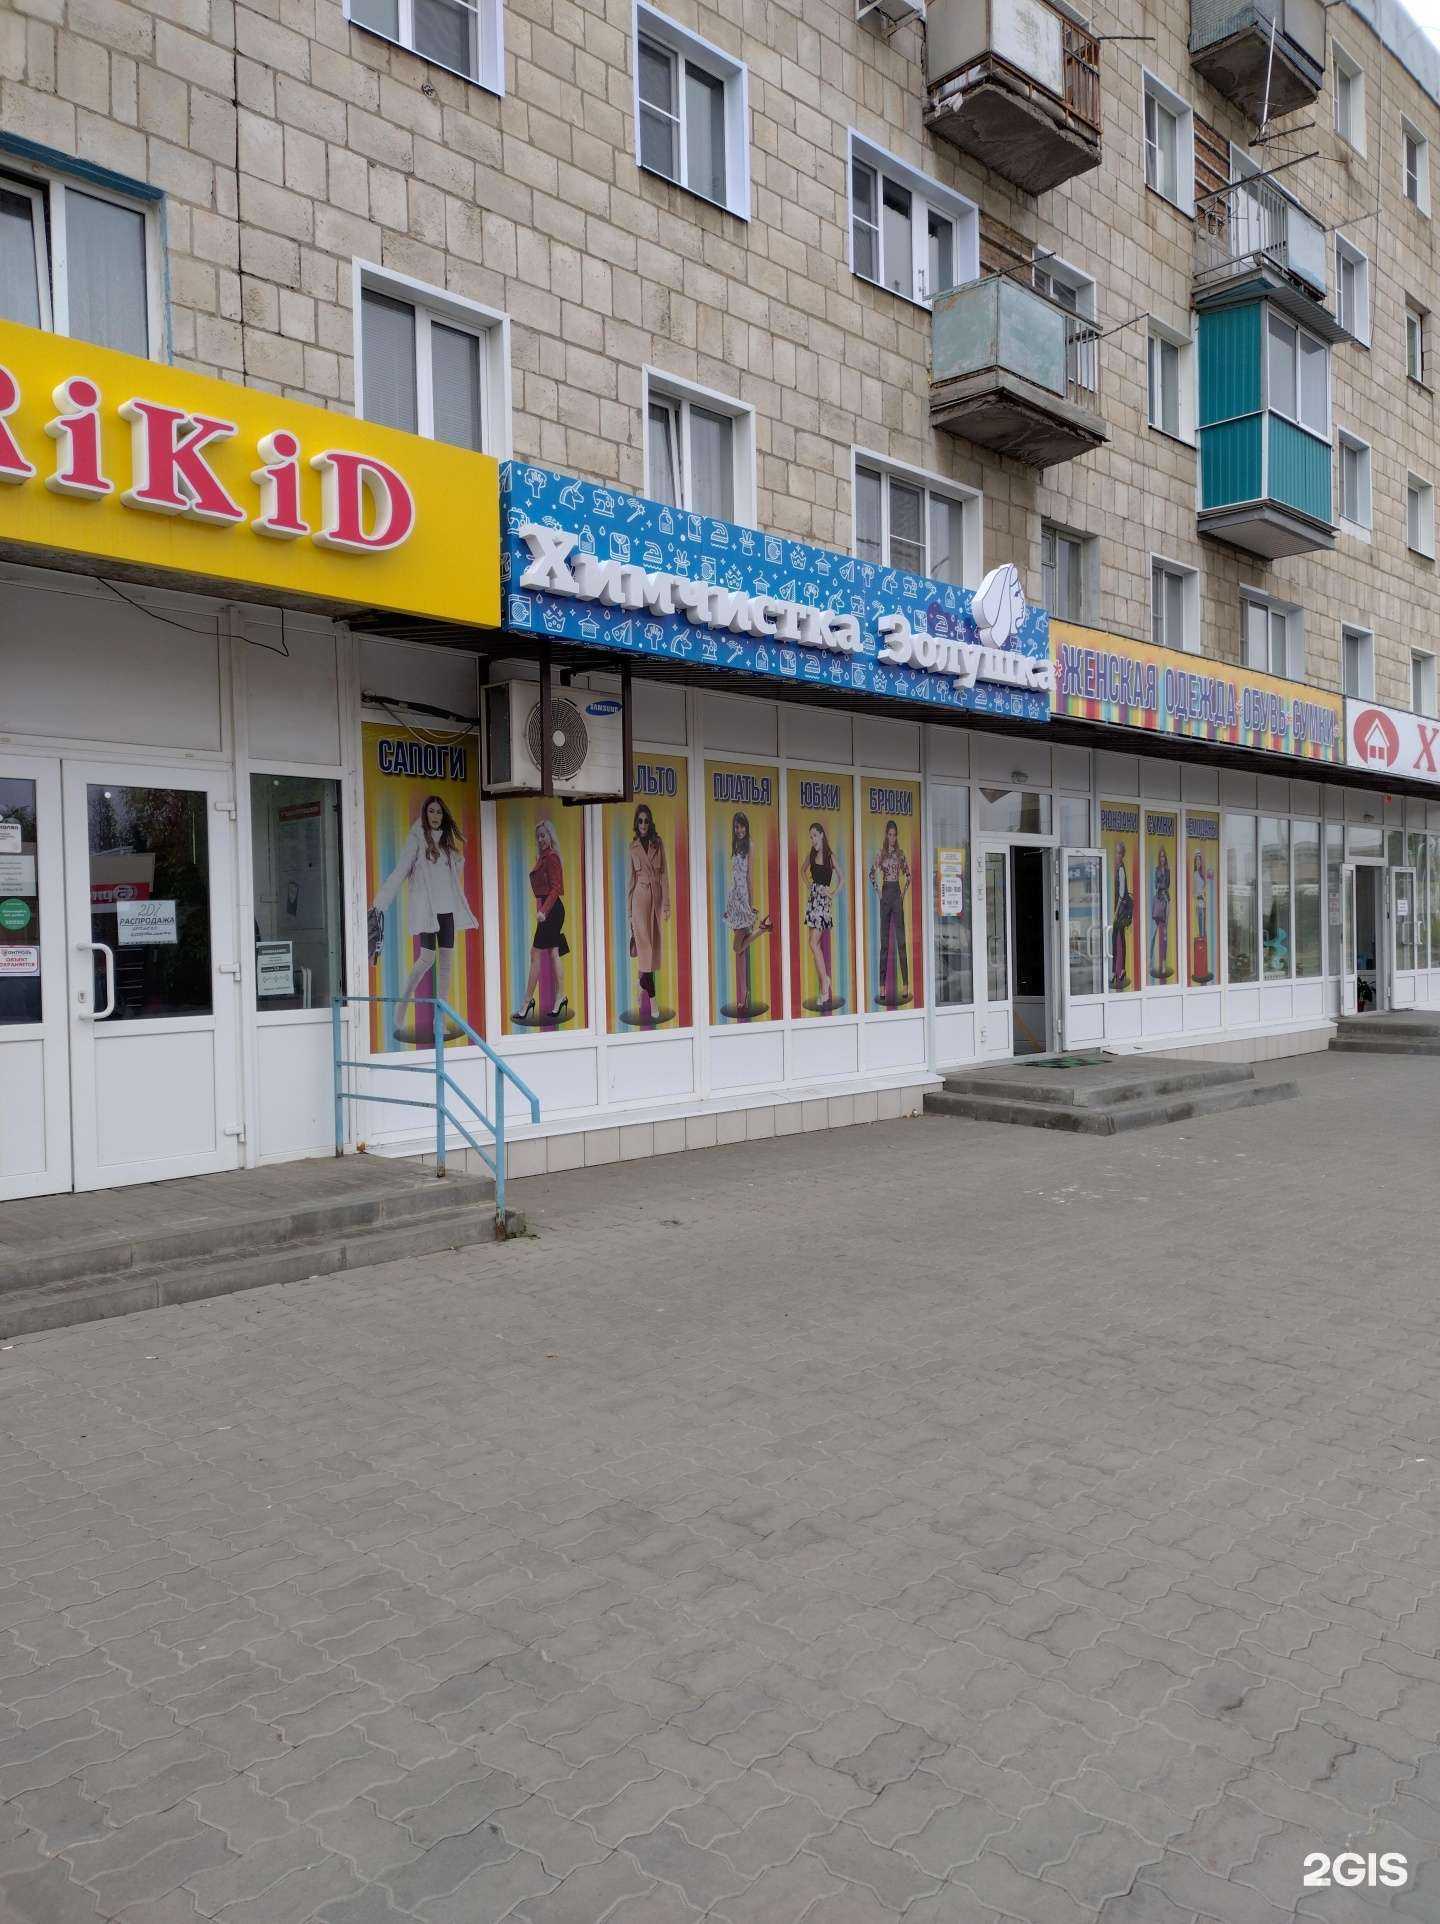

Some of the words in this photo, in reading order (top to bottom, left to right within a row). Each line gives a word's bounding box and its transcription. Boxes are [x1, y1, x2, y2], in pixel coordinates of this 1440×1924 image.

[518, 522, 864, 656] Химчистка
[878, 614, 1057, 691] Золушка
[1062, 643, 1159, 711] ЖЕНСКАЯ
[1164, 668, 1238, 728] ОДЕЖДА
[1242, 687, 1288, 737] ОБУВЬ
[1292, 699, 1336, 747] СУМКИ
[378, 739, 466, 781] САПОГИ
[632, 764, 678, 797] ЛЬТО
[712, 771, 772, 806] ПЛАТЬЯ
[799, 781, 841, 811] ЮБКИ
[869, 786, 913, 817] БРЮКИ
[120, 915, 175, 925] РАСПРОДАЖА
